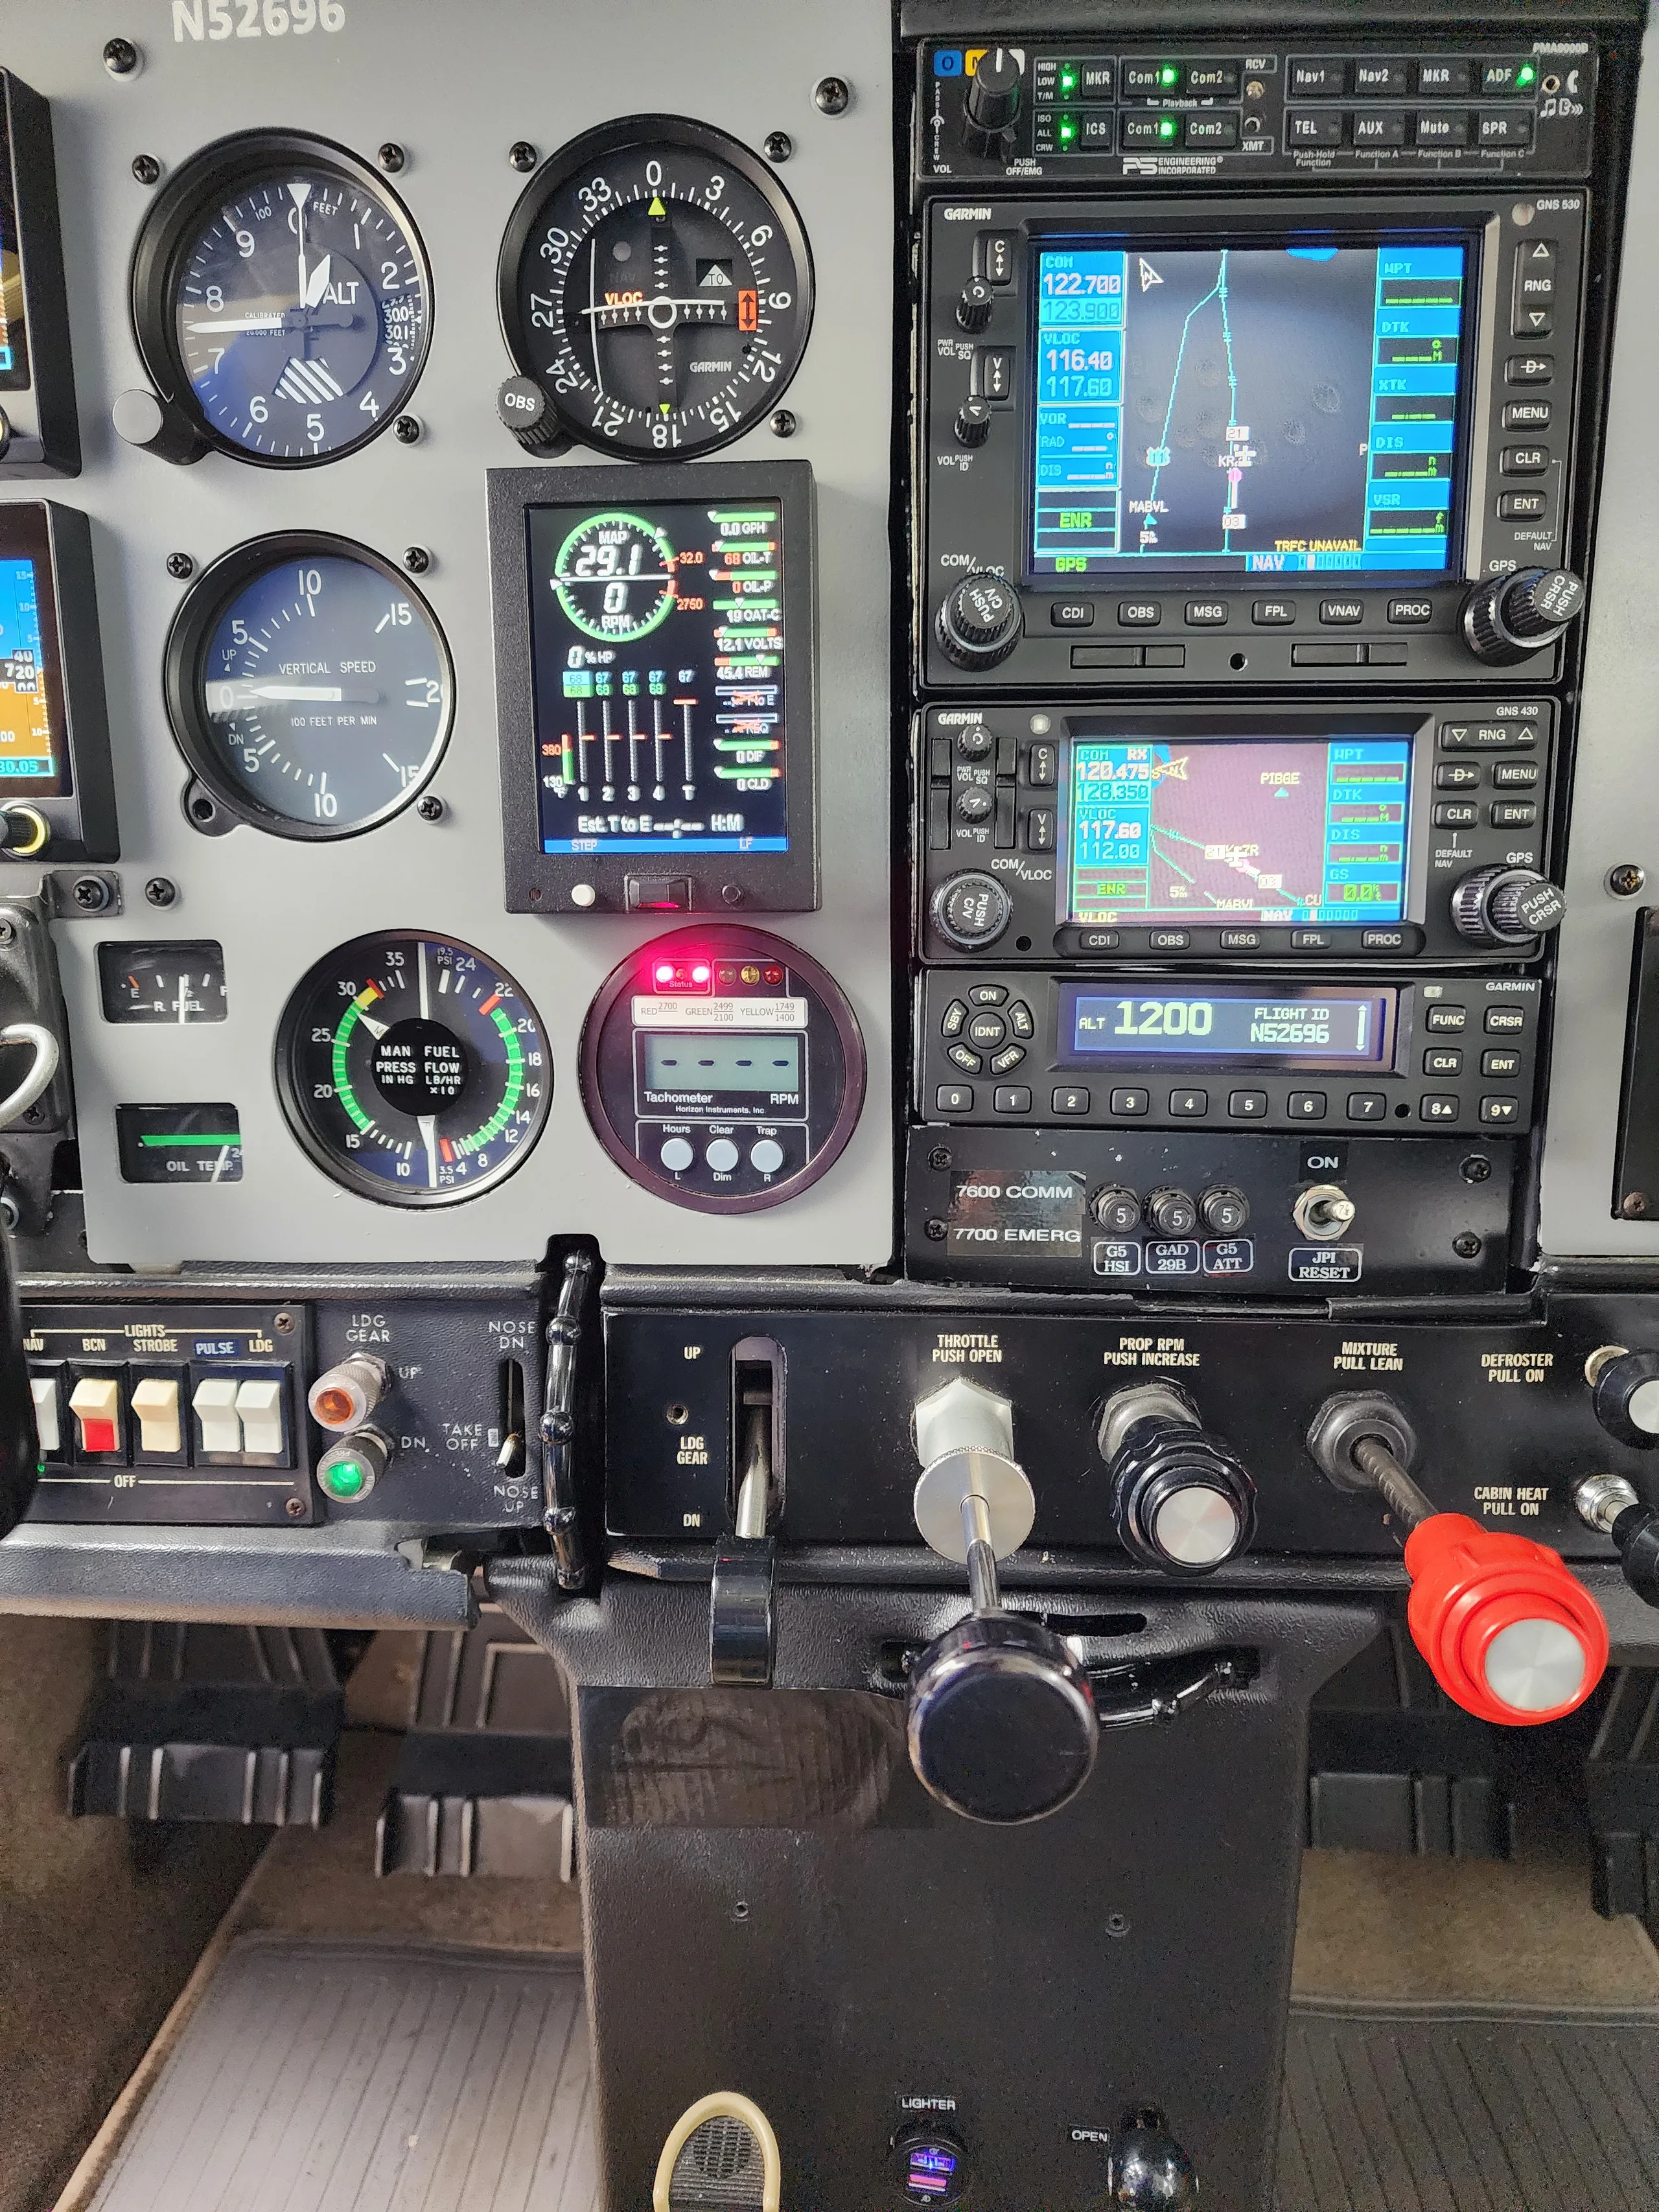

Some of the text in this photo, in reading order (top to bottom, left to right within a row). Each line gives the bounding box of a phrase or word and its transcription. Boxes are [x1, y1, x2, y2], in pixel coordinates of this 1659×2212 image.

[172, 0, 346, 42] N52696
[1038, 76, 1055, 86] LOW
[1085, 71, 1110, 86] MKR
[1190, 69, 1224, 84] Com2
[1422, 69, 1449, 82] MKR
[1487, 69, 1512, 82] ADF
[1127, 122, 1160, 135] Com1
[1295, 122, 1317, 135] TEL
[1358, 122, 1383, 135] AUX
[1242, 141, 1264, 152] XMT
[1014, 158, 1036, 167] PUSH
[1158, 166, 1216, 175] INCORPORATED
[578, 176, 612, 213] 33
[313, 202, 338, 216] FEET
[1537, 199, 1581, 210] GNS 530
[944, 208, 992, 220] GARMIN
[540, 227, 569, 264] 30
[708, 274, 724, 285] TO
[1043, 273, 1121, 295] 122.700
[1524, 280, 1551, 292] RNG
[323, 282, 358, 305] ALT
[604, 292, 644, 306] VLOC
[529, 294, 553, 329] 27
[1043, 301, 1119, 320] 123.900
[1381, 321, 1410, 332] DTK
[1047, 349, 1113, 371] 116.40
[690, 362, 732, 373] GARMIN
[752, 352, 783, 383] 12
[1047, 376, 1113, 397] 117.60
[504, 393, 536, 412] OBS
[1512, 408, 1549, 419] MENU
[592, 405, 625, 437] 21
[652, 423, 682, 448] 18
[1041, 436, 1065, 447] RAD
[1375, 436, 1404, 448] DIS
[1515, 452, 1541, 464] CLR
[1129, 501, 1170, 513] MABVL
[1513, 498, 1539, 509] ENT
[1060, 512, 1092, 528] ENR
[1514, 532, 1552, 541] DEFAULT
[1275, 539, 1362, 552] TRFC UNAVAIL
[575, 544, 641, 577] 29.1
[679, 552, 704, 564] 32.0
[1056, 557, 1087, 572] GPS
[1489, 560, 1516, 572] GPS
[1553, 581, 1579, 617] PUSH
[1062, 607, 1084, 619] CDI
[1128, 606, 1154, 619] OBS
[1194, 605, 1222, 619] MSG
[1264, 605, 1287, 618] FPL
[1328, 605, 1360, 617] VNAV
[1395, 604, 1431, 617] PROC
[717, 638, 783, 651] 12.1 VOLTS
[279, 661, 377, 675] VERTICAL SPEED
[291, 716, 377, 727] 100 FEET PER MIN
[938, 713, 982, 725] GARMIN
[1479, 729, 1506, 740] RNG
[1076, 761, 1150, 780] 120.475
[1502, 769, 1537, 780] MENU
[1077, 783, 1148, 800] 128.350
[1333, 789, 1362, 800] DTK
[1447, 809, 1472, 820] CLR
[1504, 809, 1529, 820] ENT
[572, 841, 597, 852] STEP
[1080, 841, 1140, 859] 112.00
[1435, 850, 1472, 858] DEFAULT
[1506, 852, 1533, 865] GPS
[1330, 868, 1349, 880] GS
[1528, 900, 1562, 926] CRSR
[1089, 935, 1111, 946] CDI
[1157, 935, 1184, 946] OBS
[1228, 935, 1256, 945] MSG
[1303, 935, 1325, 945] FPL
[1367, 934, 1401, 945] PROC
[1485, 982, 1535, 992] GARMIN
[980, 991, 997, 1001] ON
[641, 1002, 678, 1016] RED 2700
[685, 1002, 734, 1016] GREEN 2499
[775, 1013, 795, 1021] 1400
[1114, 1001, 1213, 1036] 1200
[1432, 1014, 1465, 1027] FUNC
[1490, 1016, 1523, 1027] CRSR
[1078, 1018, 1105, 1030] ALT
[975, 1027, 1000, 1036] IDNT
[1250, 1023, 1330, 1043] N52696
[380, 1046, 411, 1057] MAN
[424, 1046, 459, 1057] FUEL
[376, 1062, 416, 1073] PRESS
[424, 1062, 460, 1074] FLOW
[1433, 1058, 1457, 1069] CLR
[1491, 1060, 1514, 1071] ENT
[644, 1091, 713, 1103] Tachometer
[771, 1094, 798, 1104] RPM
[662, 1124, 691, 1134] Hours
[709, 1125, 734, 1134] Clear
[756, 1126, 777, 1137] Trap
[167, 1161, 189, 1172] OIL
[1307, 1156, 1338, 1169] ON
[713, 1172, 732, 1182] Dim
[955, 1185, 1072, 1199] 7600 COMM
[953, 1228, 1081, 1242] 7700 EMERG
[1107, 1245, 1127, 1258] G5
[1155, 1244, 1189, 1256] GAD
[1212, 1257, 1242, 1270] ATT
[1299, 1267, 1350, 1279] RESET
[353, 1316, 386, 1328] LDG
[489, 1321, 535, 1334] NOSE
[124, 1325, 165, 1337] LIGHTS
[346, 1329, 389, 1343] GEAR
[82, 1339, 106, 1351] BCN
[133, 1340, 178, 1352] STROBE
[249, 1340, 273, 1352] LDG
[937, 1334, 998, 1349] THROTTLE
[1119, 1338, 1185, 1352] PROP RPM
[196, 1342, 235, 1354] PULSE
[684, 1347, 700, 1359] UP
[1341, 1342, 1398, 1357] MIXTURE
[932, 1349, 1002, 1363] PUSH OPEN
[1103, 1352, 1200, 1368] PUSH INCREASE
[1480, 1353, 1553, 1368] DEFROSTER
[1333, 1356, 1403, 1372] PULL LEAN
[1488, 1368, 1544, 1382] PULL ON
[443, 1424, 481, 1436] TAKE
[680, 1437, 704, 1449] LDG
[677, 1451, 708, 1464] GEAR
[113, 1475, 135, 1487] OFF
[494, 1486, 538, 1499] NOSE
[1474, 1486, 1549, 1502] CABIN HEAT
[1482, 1501, 1538, 1517] PULL ON
[684, 1514, 700, 1526] DN
[902, 2098, 955, 2110] LIGHTER
[1072, 2130, 1108, 2142] OPEN
